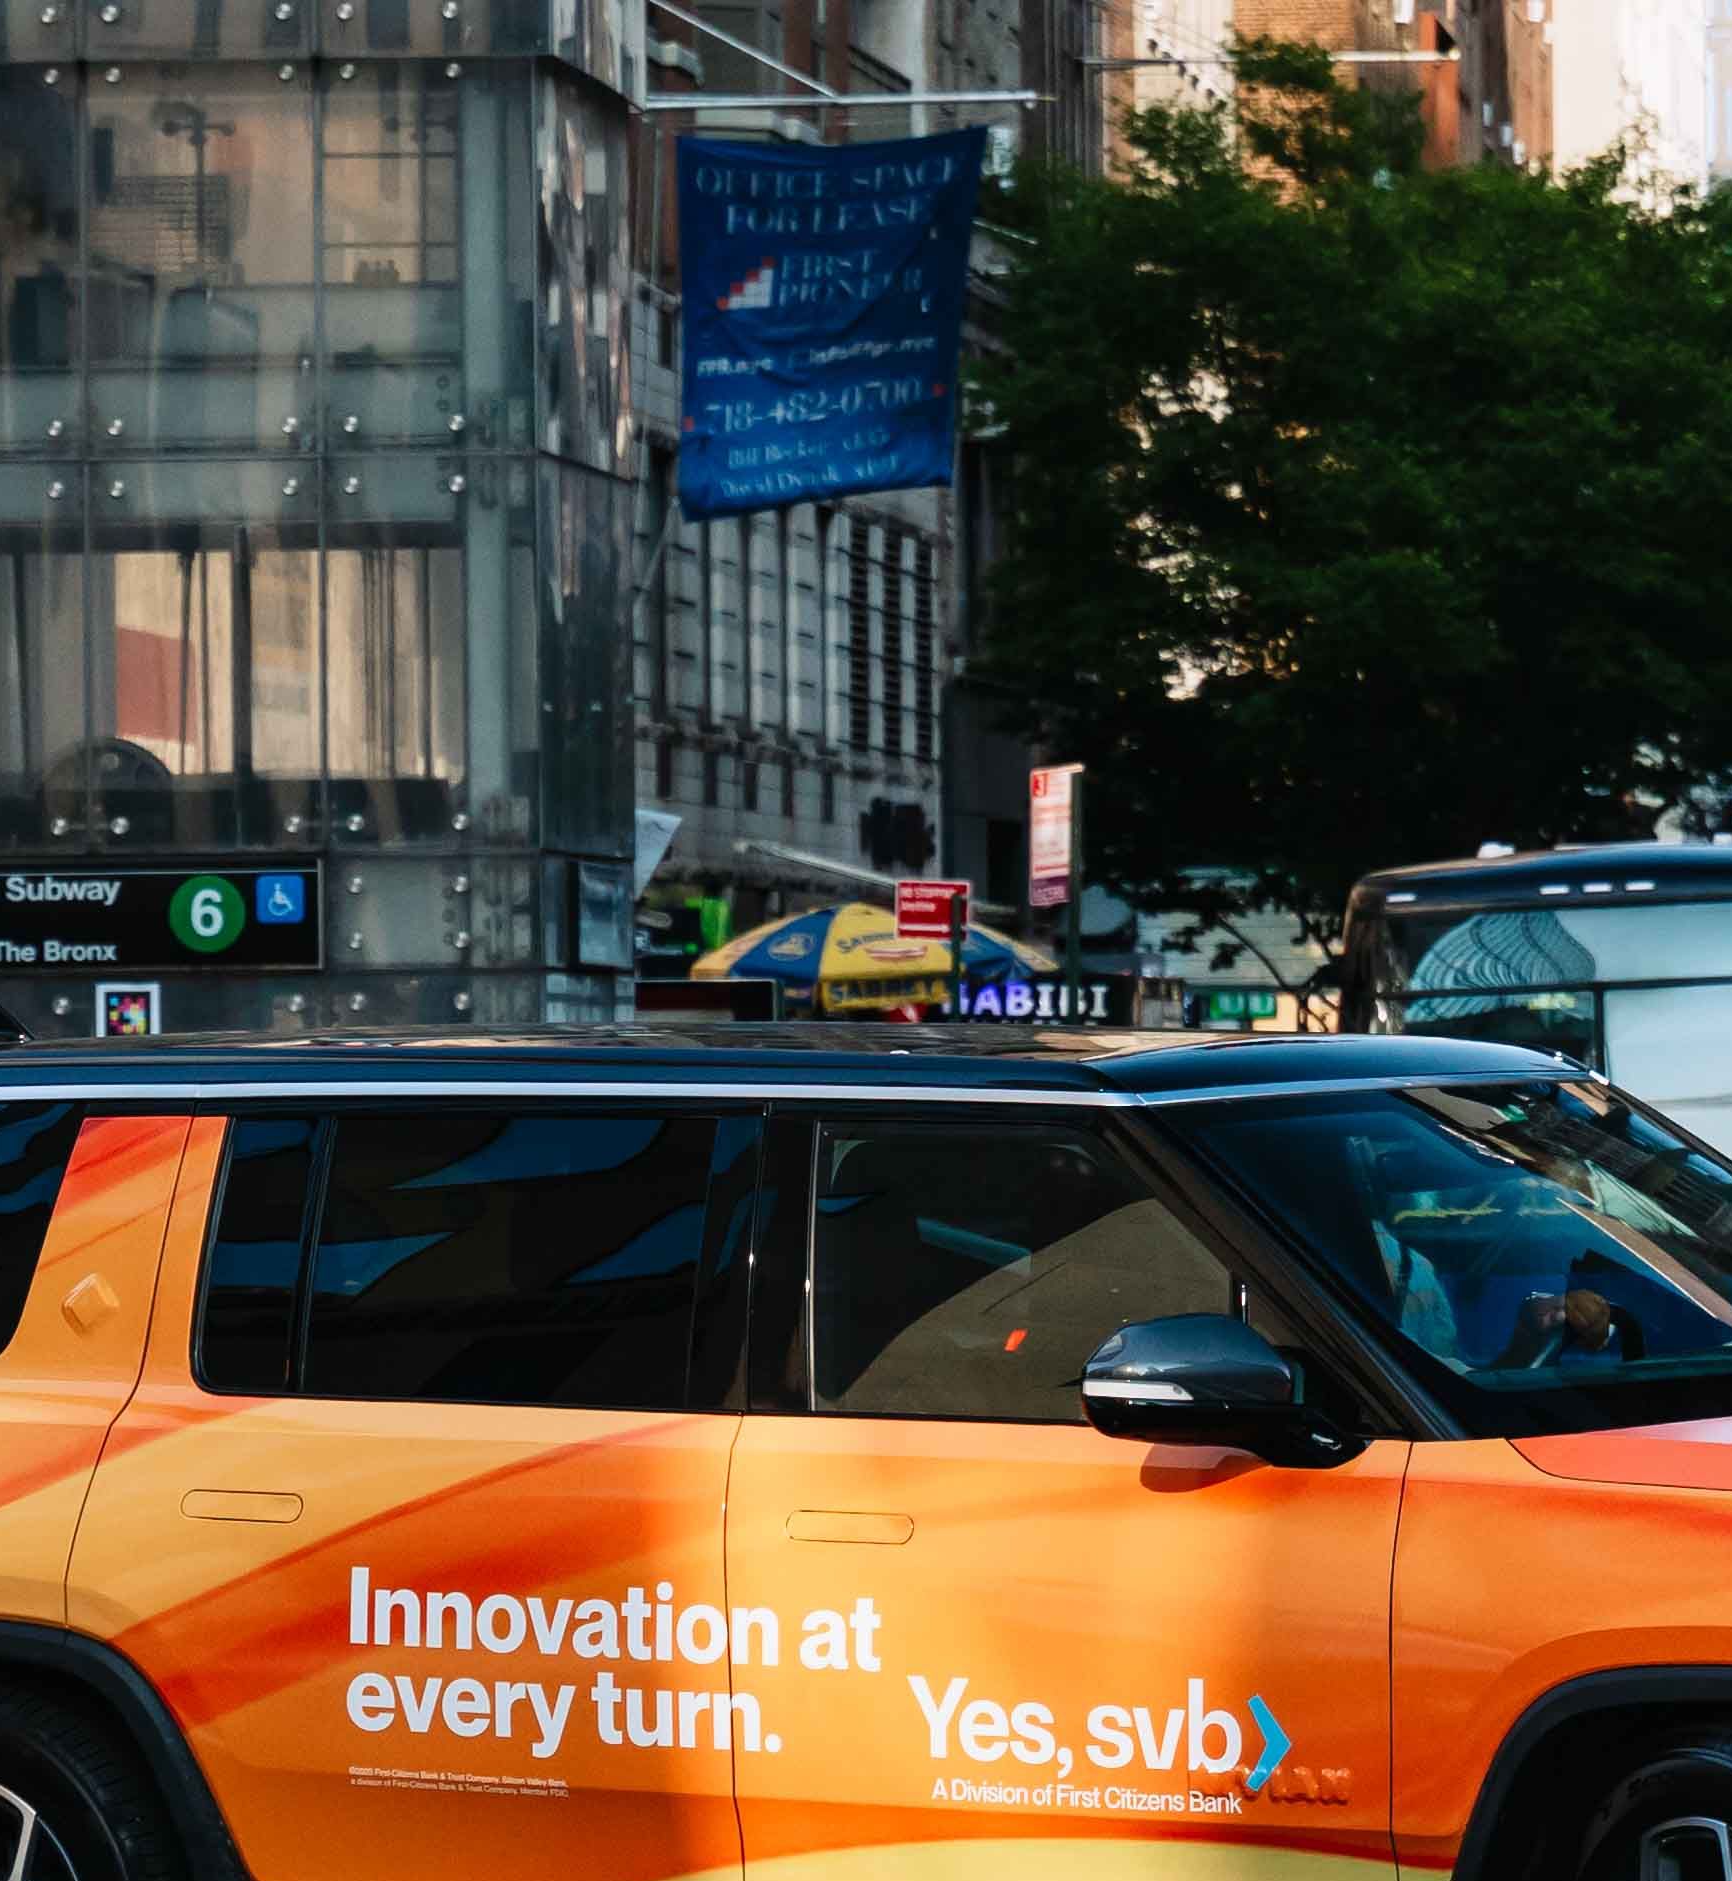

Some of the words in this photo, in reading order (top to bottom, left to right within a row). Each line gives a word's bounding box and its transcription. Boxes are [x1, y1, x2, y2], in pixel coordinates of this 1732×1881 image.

[726, 203, 800, 235] FOR
[5, 874, 121, 906] Subway
[190, 889, 224, 938] 6
[43, 939, 117, 963] Bronx
[348, 1566, 780, 1669] Innovation
[797, 1597, 882, 1673] at
[346, 1672, 575, 1759] every
[588, 1672, 783, 1755] turn.
[907, 1675, 1074, 1779] Yes,
[1085, 1678, 1243, 1774] svb
[932, 1779, 948, 1800] A
[951, 1779, 1030, 1806] Division
[1033, 1783, 1054, 1807] of
[1056, 1785, 1102, 1809] First
[1104, 1788, 1185, 1813] Citizens
[1189, 1791, 1243, 1815] Bank
